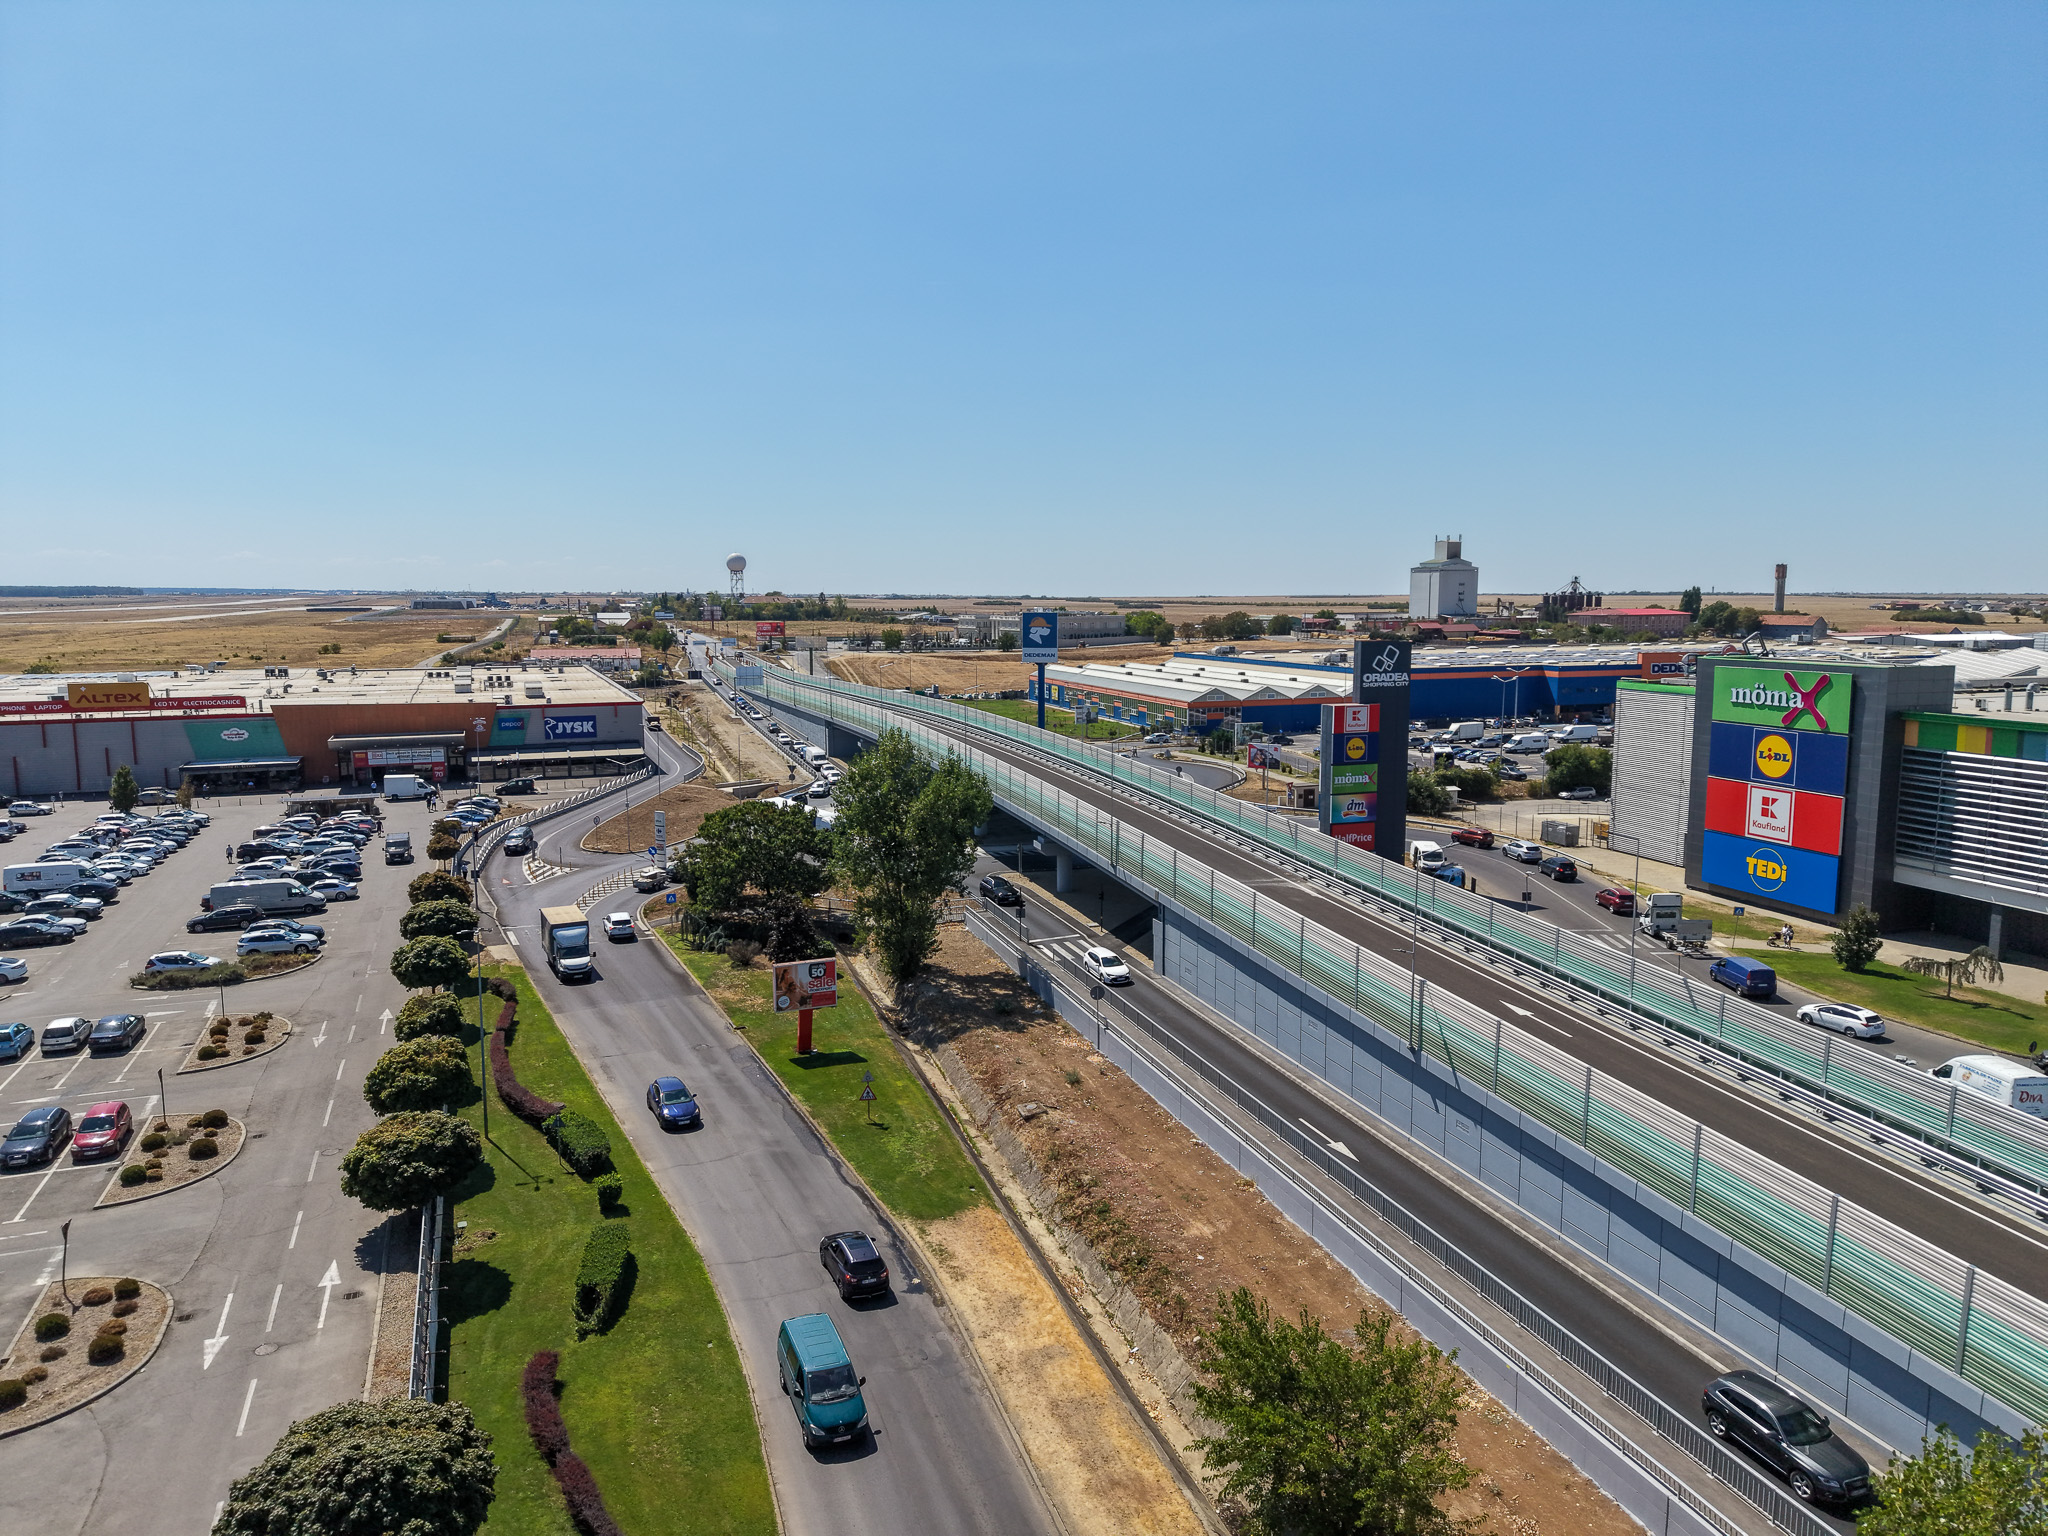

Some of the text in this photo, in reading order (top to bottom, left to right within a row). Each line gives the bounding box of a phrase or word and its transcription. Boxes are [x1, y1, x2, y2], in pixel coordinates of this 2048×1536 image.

[1362, 672, 1409, 682] ORADEA
[555, 721, 594, 734] JYSK
[1346, 799, 1365, 811] dm
[1752, 820, 1786, 833] Kaufland
[1335, 833, 1372, 843] HalfPrice
[1746, 856, 1787, 882] TEDi
[808, 976, 834, 989] sale
